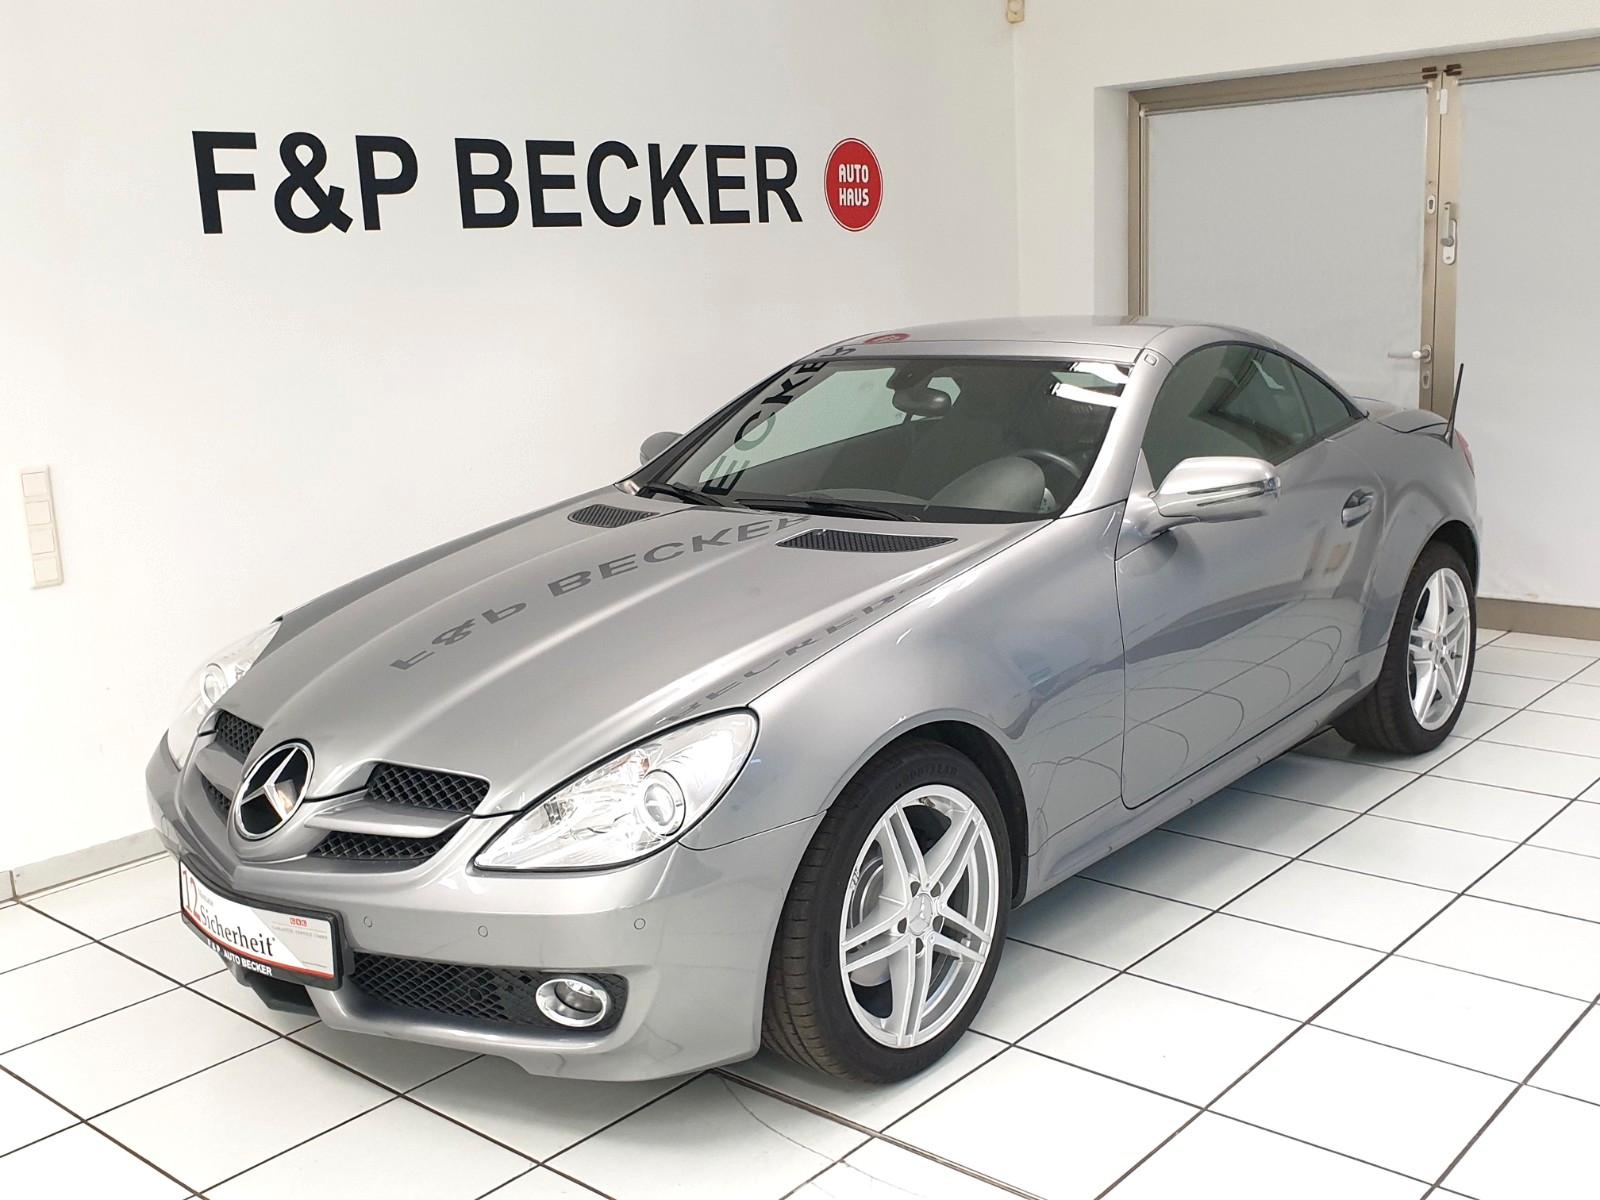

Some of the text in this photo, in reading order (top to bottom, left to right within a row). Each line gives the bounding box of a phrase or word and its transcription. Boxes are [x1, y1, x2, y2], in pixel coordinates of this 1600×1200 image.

[191, 130, 804, 234] F&P BECKER
[838, 163, 869, 183] AUTO
[838, 187, 870, 206] HAUS
[223, 949, 273, 977] AUTO BECKER
